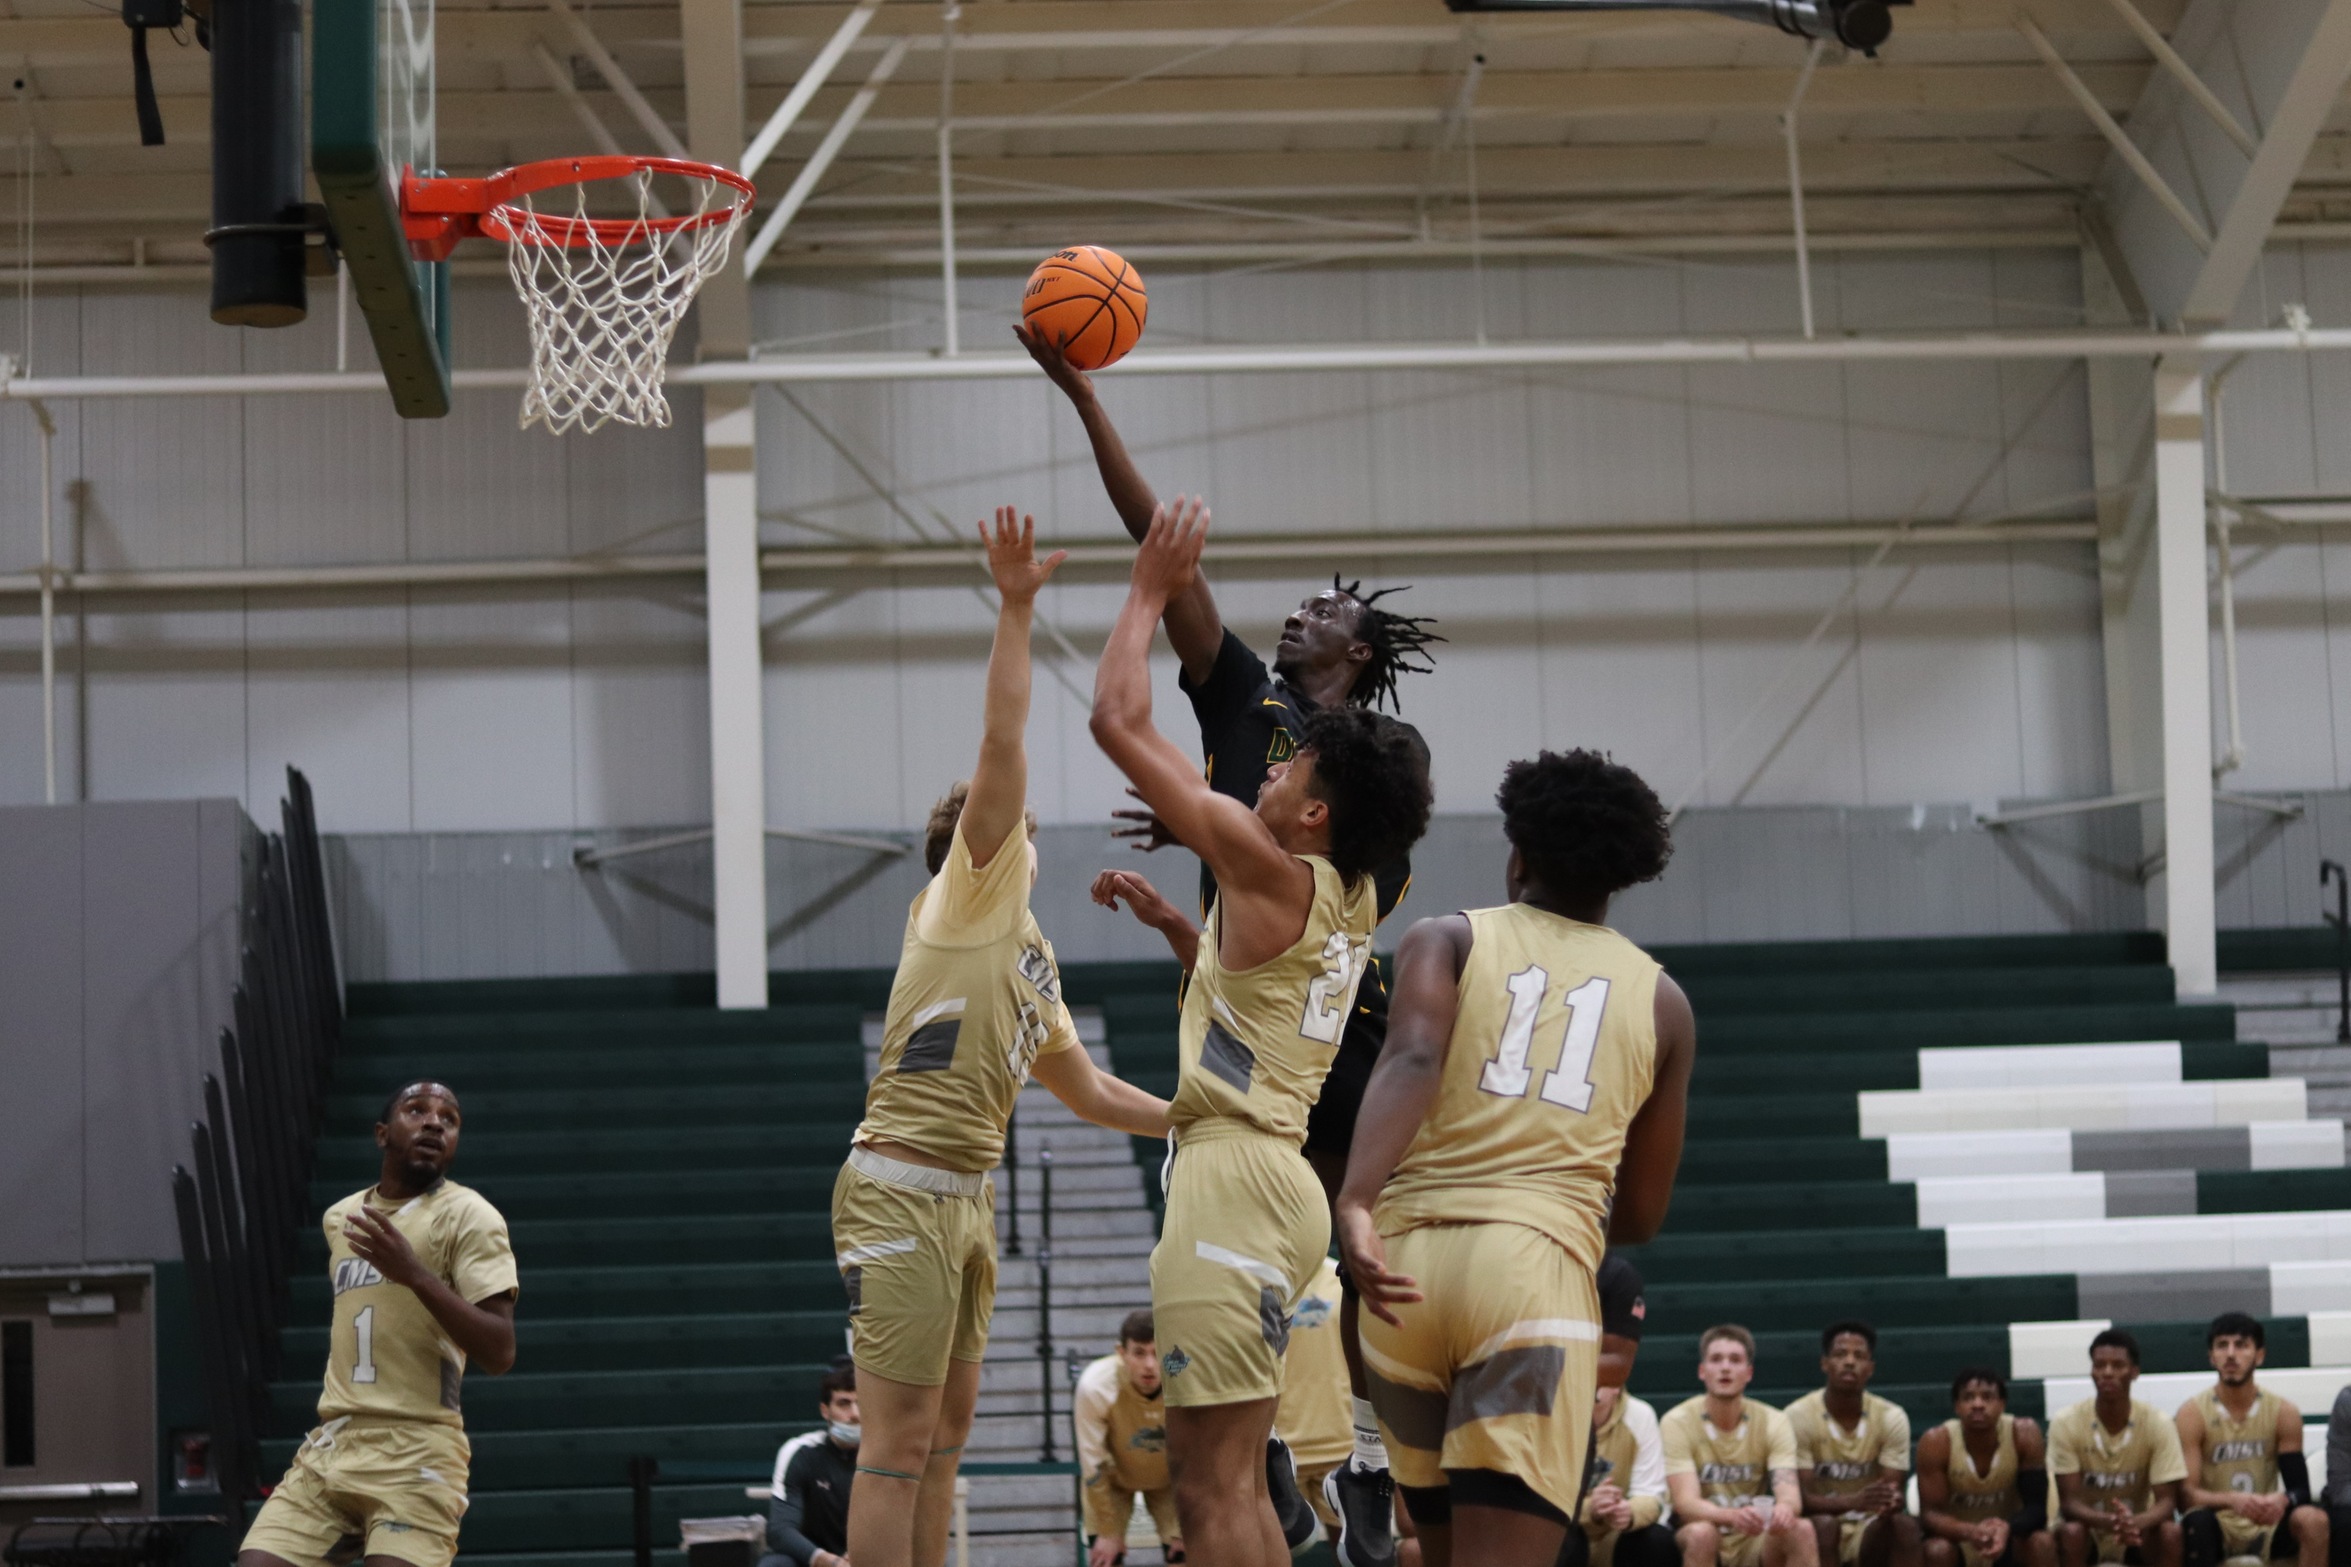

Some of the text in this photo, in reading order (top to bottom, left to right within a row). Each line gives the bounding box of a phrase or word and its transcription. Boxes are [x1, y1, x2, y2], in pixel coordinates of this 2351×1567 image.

[1055, 250, 1078, 262] on
[1477, 963, 1611, 1115] 11
[334, 1256, 392, 1298] CMS
[352, 1305, 376, 1383] 1
